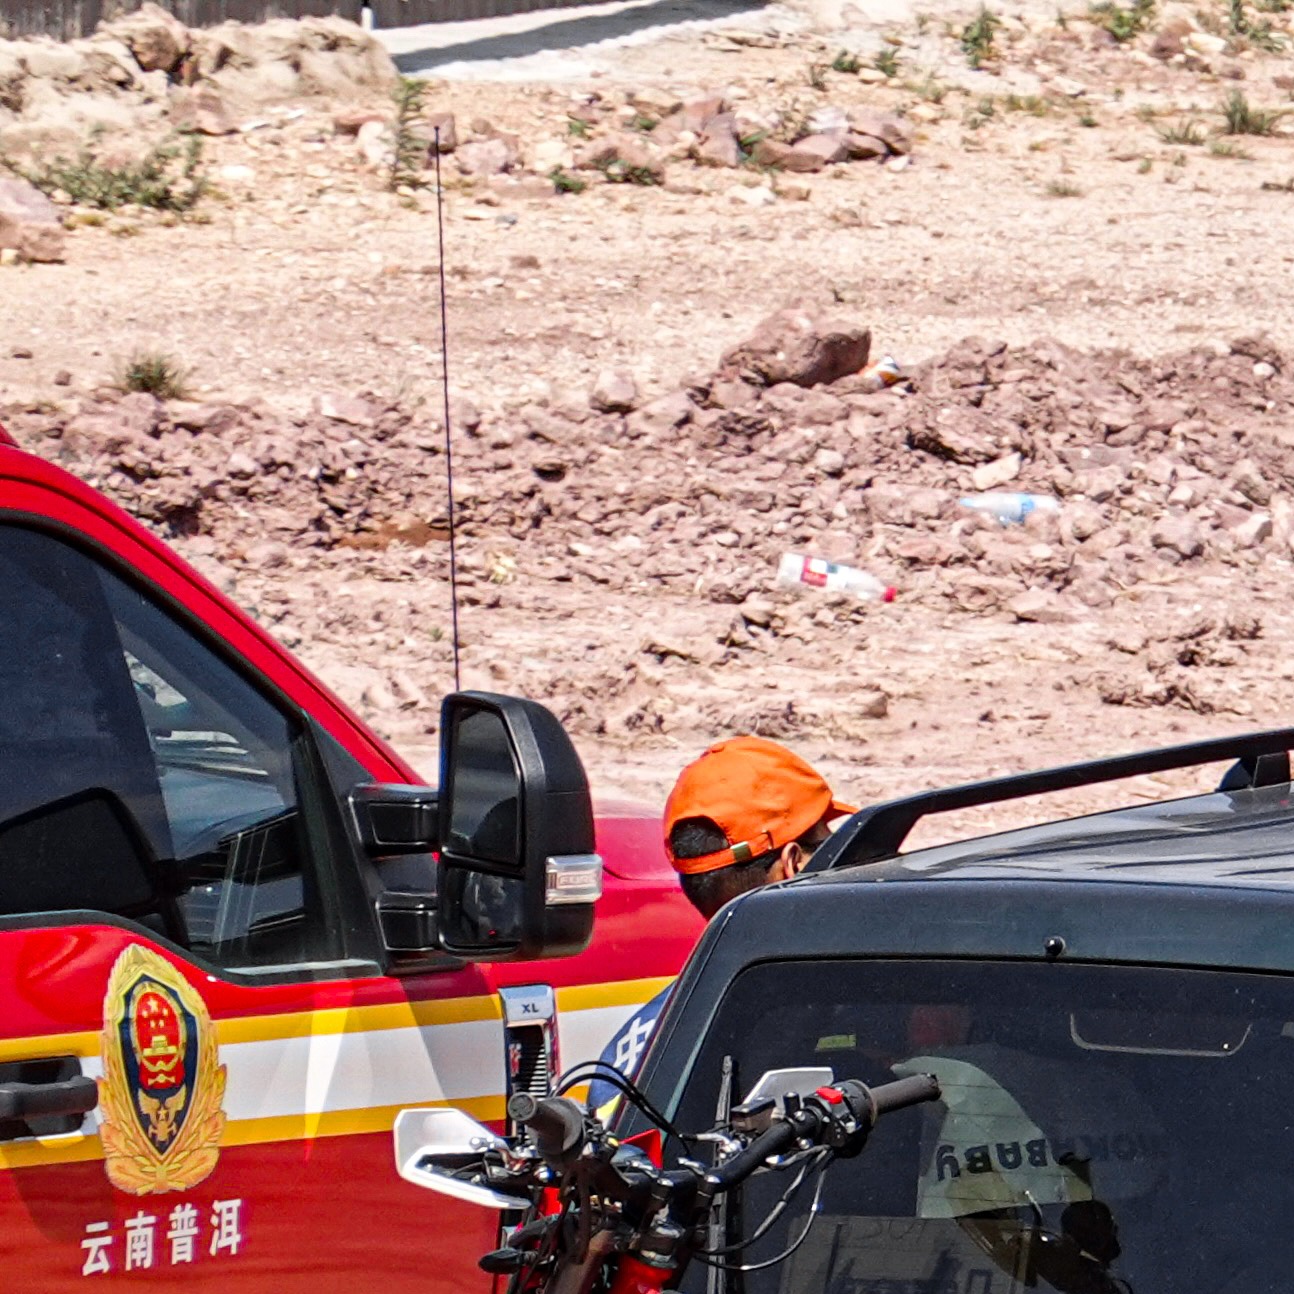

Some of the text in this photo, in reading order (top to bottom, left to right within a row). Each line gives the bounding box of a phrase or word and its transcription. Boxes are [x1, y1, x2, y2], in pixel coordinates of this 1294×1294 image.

[522, 1003, 540, 1014] XL
[81, 1198, 243, 1277] 云南普洱
